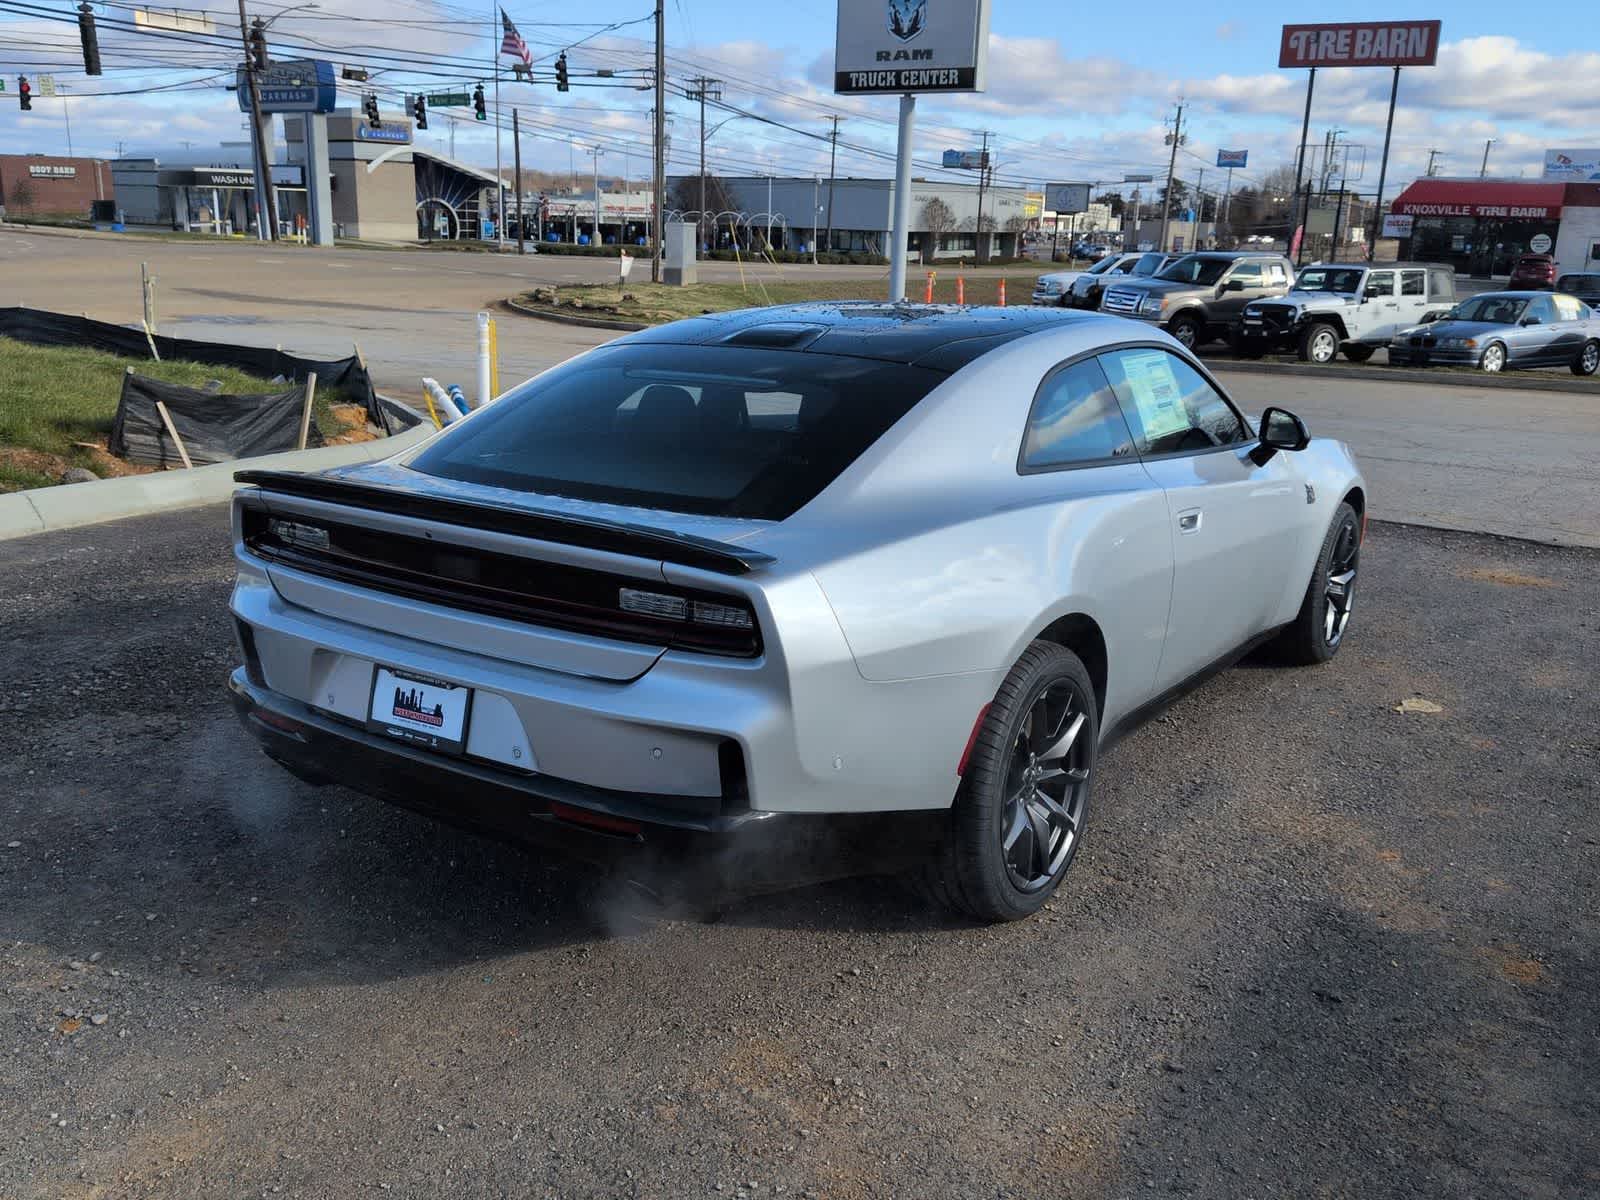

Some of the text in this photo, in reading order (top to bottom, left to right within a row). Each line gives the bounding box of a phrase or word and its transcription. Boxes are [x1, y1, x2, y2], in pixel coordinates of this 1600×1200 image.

[1355, 27, 1430, 59] BARN
[876, 49, 933, 61] RAM
[850, 69, 958, 87] TRUCK CENTER
[211, 175, 238, 184] WASH
[1403, 204, 1471, 216] KNOXVILLE
[1510, 207, 1547, 217] BARN
